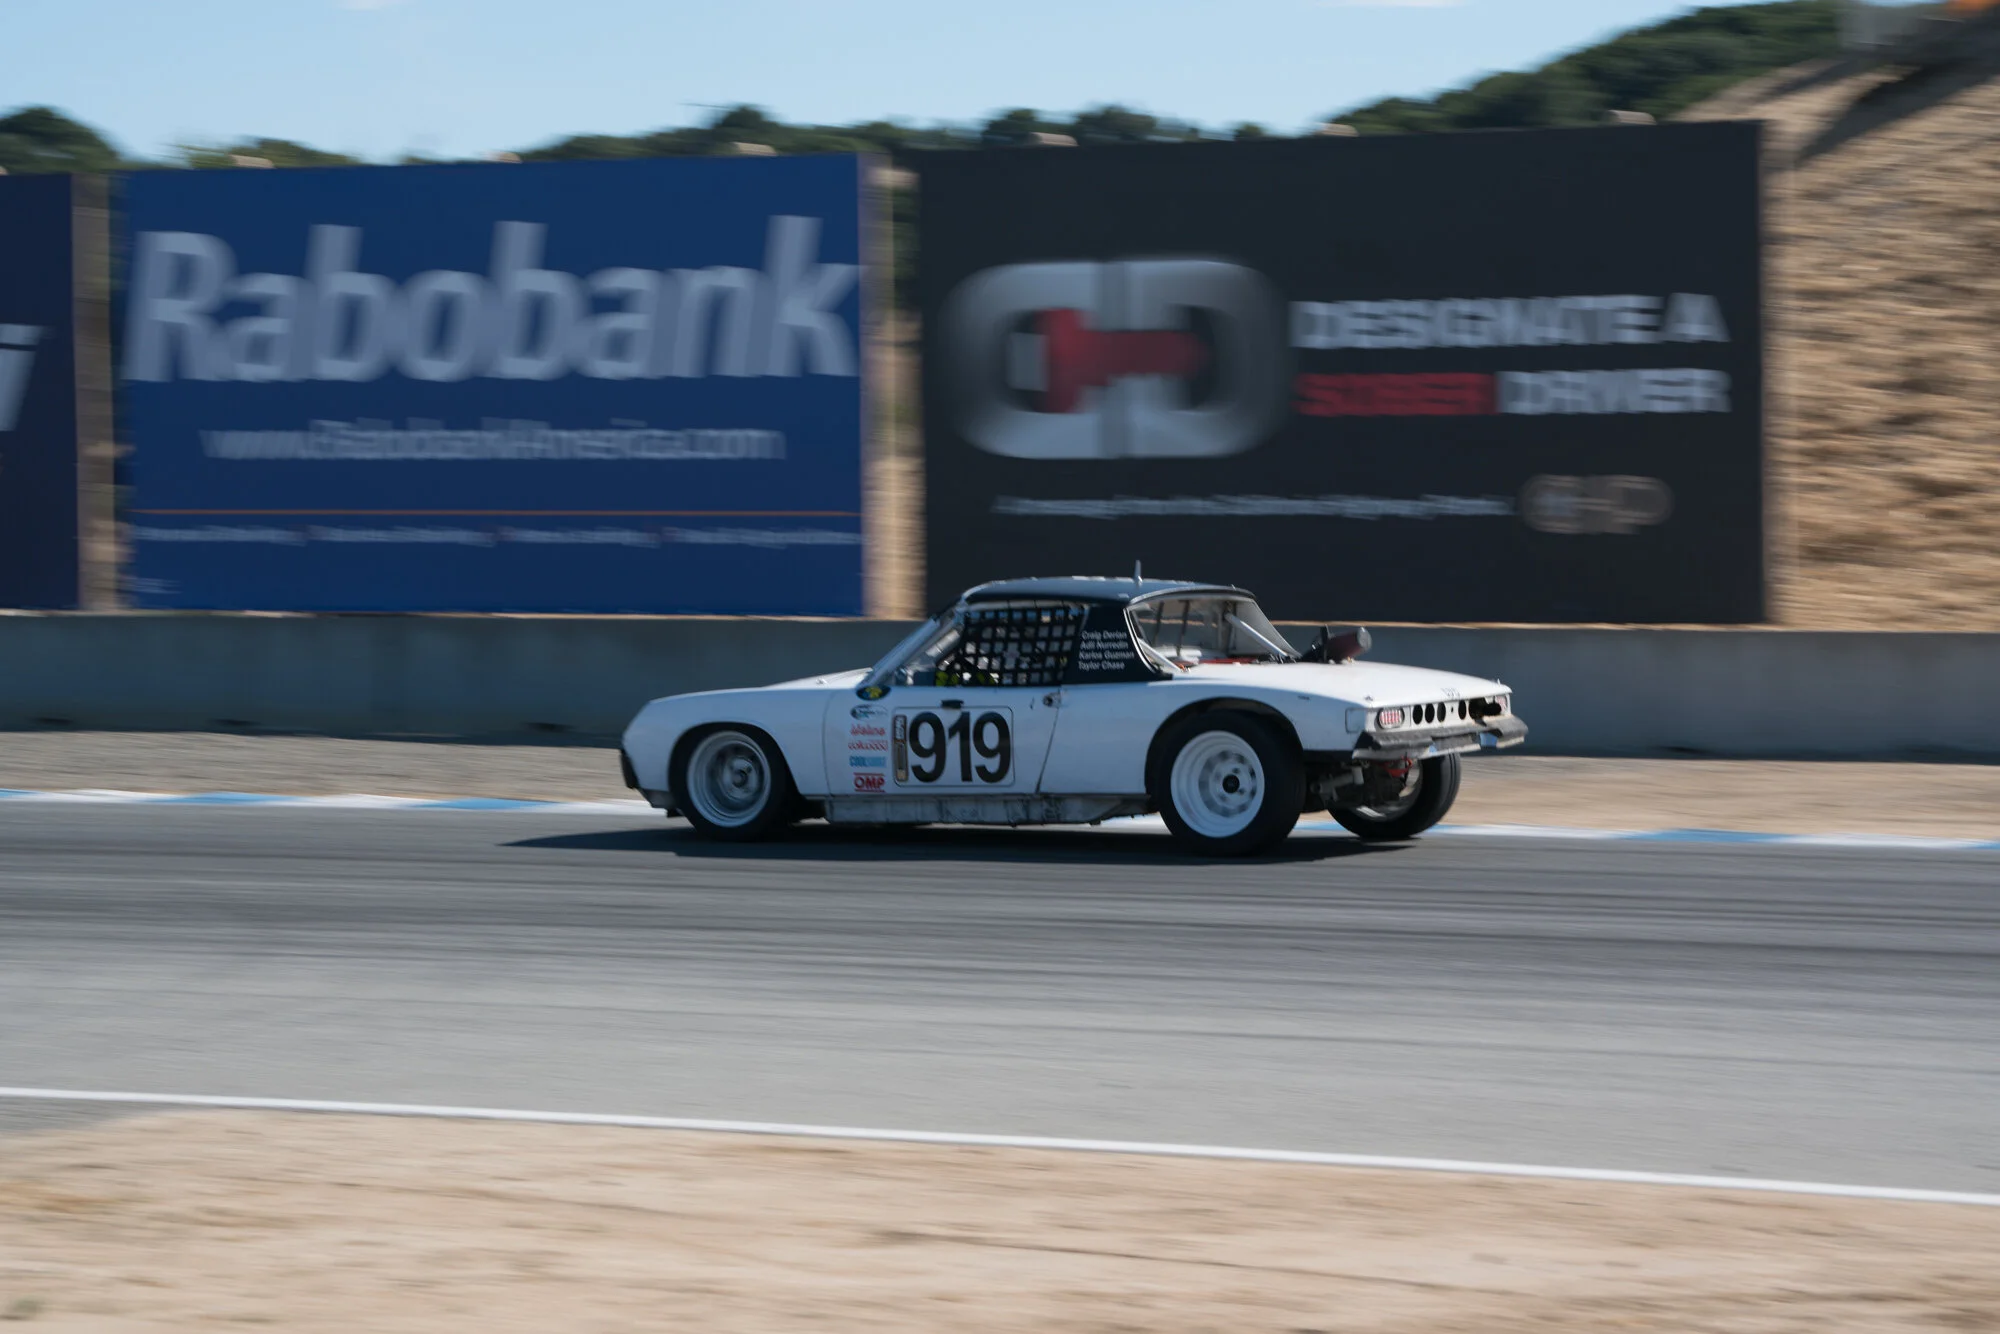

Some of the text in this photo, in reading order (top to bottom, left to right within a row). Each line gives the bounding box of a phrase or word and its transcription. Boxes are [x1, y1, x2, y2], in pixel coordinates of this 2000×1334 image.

[121, 214, 866, 382] Rabobank
[1660, 293, 1731, 343] A
[908, 711, 1011, 783] 919
[854, 775, 886, 790] OMP
